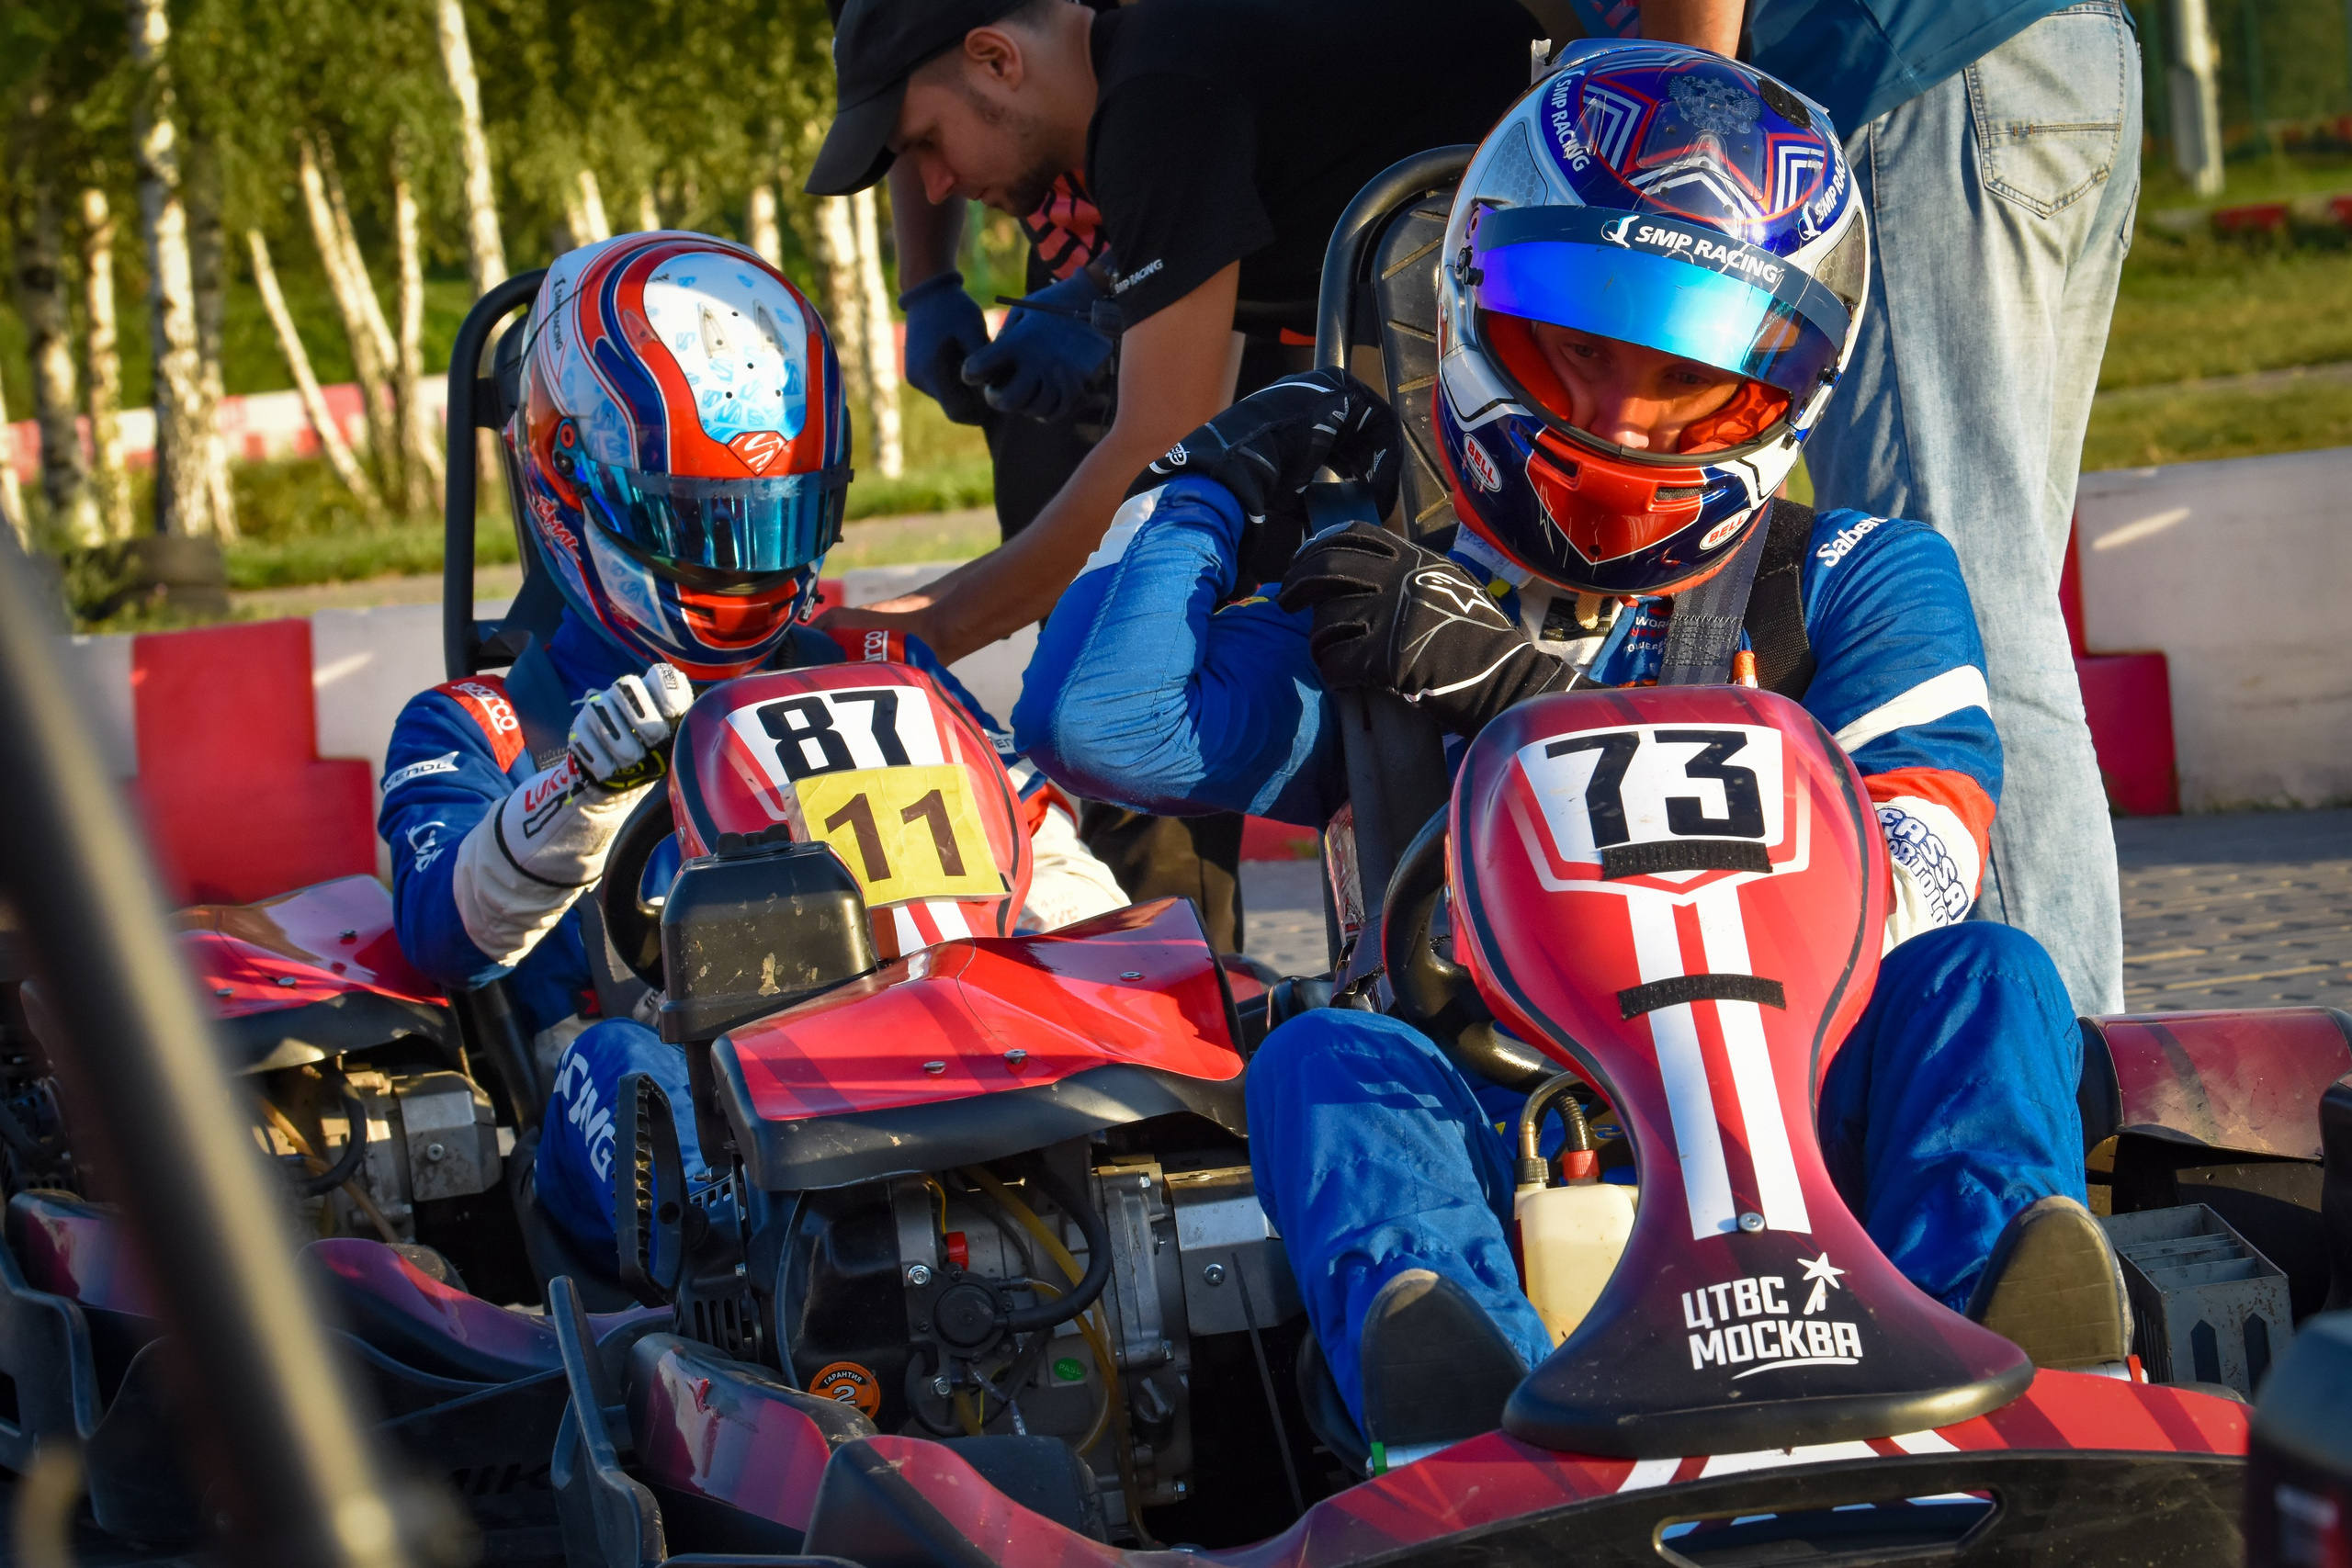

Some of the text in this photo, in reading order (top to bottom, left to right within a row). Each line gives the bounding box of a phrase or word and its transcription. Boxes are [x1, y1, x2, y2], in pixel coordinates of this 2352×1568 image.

[1551, 78, 1590, 172] SMP RACING
[1815, 185, 1838, 225] SMP
[1130, 258, 1163, 286] RACING
[1635, 225, 1781, 284] SMP RACING
[1467, 439, 1495, 484] BELL
[1708, 515, 1745, 544] BELL
[451, 682, 518, 732] sparco
[756, 689, 911, 784] 87
[1545, 729, 1766, 849] 73
[824, 789, 967, 883] 11
[1681, 1276, 1790, 1329] ЦТВС
[1688, 1319, 1863, 1371] МОСКВА
[823, 1371, 864, 1385] ГАРАНТИЯ
[833, 1385, 856, 1405] 2
